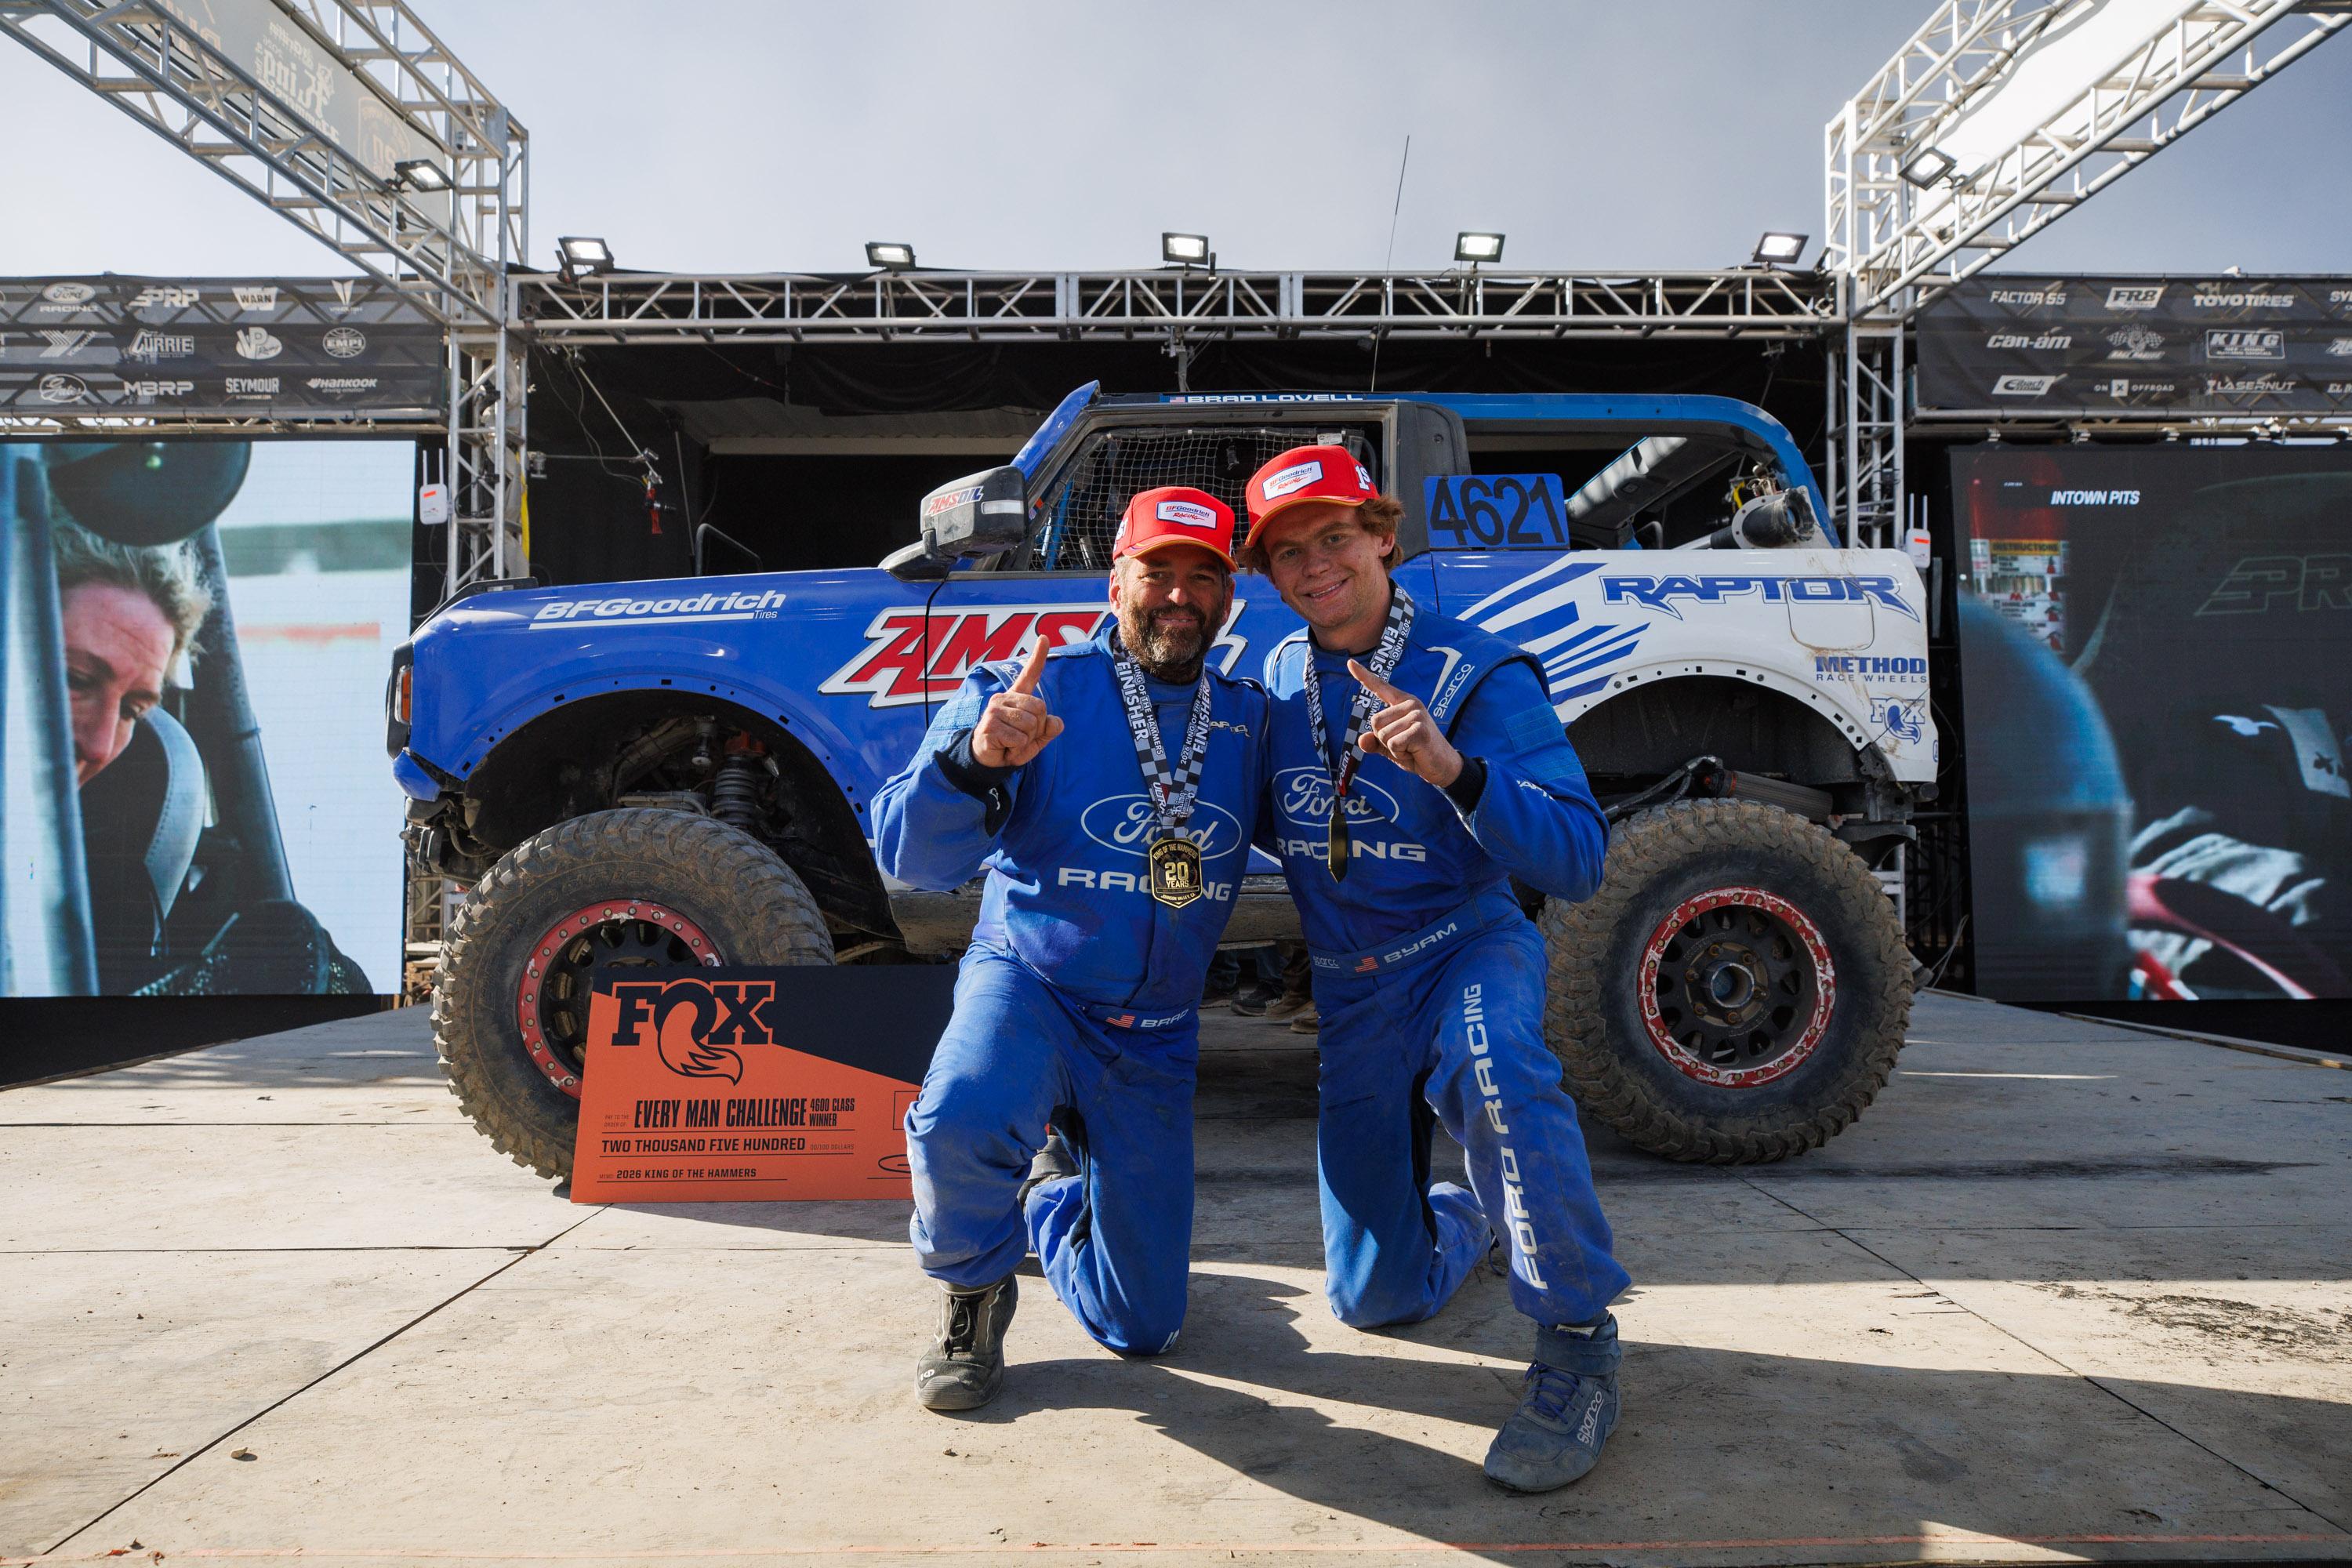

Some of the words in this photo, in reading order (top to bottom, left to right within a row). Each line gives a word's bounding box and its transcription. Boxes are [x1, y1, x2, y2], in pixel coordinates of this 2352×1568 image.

[240, 294, 272, 303] WARN
[1990, 291, 2044, 305] FACTOR
[2113, 290, 2158, 301] FR8
[2193, 295, 2244, 307] TOYO
[2245, 295, 2295, 307] TIRES
[132, 331, 194, 353] CURRIE
[237, 327, 267, 358] VP
[326, 339, 361, 347] EMPI
[2210, 333, 2280, 346] KING
[123, 381, 194, 396] MBRP
[226, 377, 280, 393] SEYMOUR
[927, 486, 984, 516] AMSOIL
[2051, 491, 2107, 505] INTOWN
[2109, 491, 2140, 505] PITS
[1429, 476, 1566, 545] 4621
[534, 590, 786, 622] BFGoodrich
[1599, 574, 1921, 623] RAPTOR
[752, 609, 779, 619] Tires
[1400, 619, 1411, 637] 2026
[1392, 637, 1405, 659] KING
[1134, 664, 1144, 684] KING
[1356, 626, 1399, 709] FINISER
[1386, 659, 1396, 671] OF
[1816, 656, 1926, 674] METHOD
[1138, 684, 1147, 695] OF
[1864, 675, 1927, 684] WHEELS
[1433, 664, 1472, 718] sparco
[1116, 662, 1149, 741] FINISHER
[1142, 697, 1152, 713] THE
[1192, 685, 1211, 754] FINISHER
[1871, 697, 1926, 745] FOX
[1146, 714, 1163, 756] HAMMERS
[1180, 746, 1190, 765] 2026
[1185, 726, 1196, 746] KING
[1191, 714, 1198, 724] OF
[1152, 848, 1164, 861] KING
[1277, 837, 1426, 862] RACNG
[1164, 862, 1189, 881] 20
[1384, 922, 1458, 964] BYAM
[1140, 1008, 1189, 1028] BRAD
[612, 978, 775, 1086] FOX
[1464, 983, 1510, 1134] RACING
[633, 1099, 681, 1128] EVERY
[685, 1098, 720, 1128] MAN
[725, 1098, 808, 1127] CHALLENGE
[810, 1098, 829, 1112] 4600
[832, 1098, 855, 1112] CLASS
[809, 1112, 837, 1127] WINNER
[602, 1139, 631, 1152] TWO
[635, 1139, 706, 1152] THOUSAND
[709, 1138, 739, 1152] FIVE
[743, 1138, 806, 1152] HUNDRED
[616, 1170, 641, 1179] 2026
[644, 1169, 670, 1178] KING
[672, 1169, 684, 1178] OF
[687, 1169, 705, 1178] THE
[707, 1168, 757, 1178] HAMMERS
[1501, 1145, 1548, 1290] FORD
[1577, 1391, 1602, 1443] sparco
